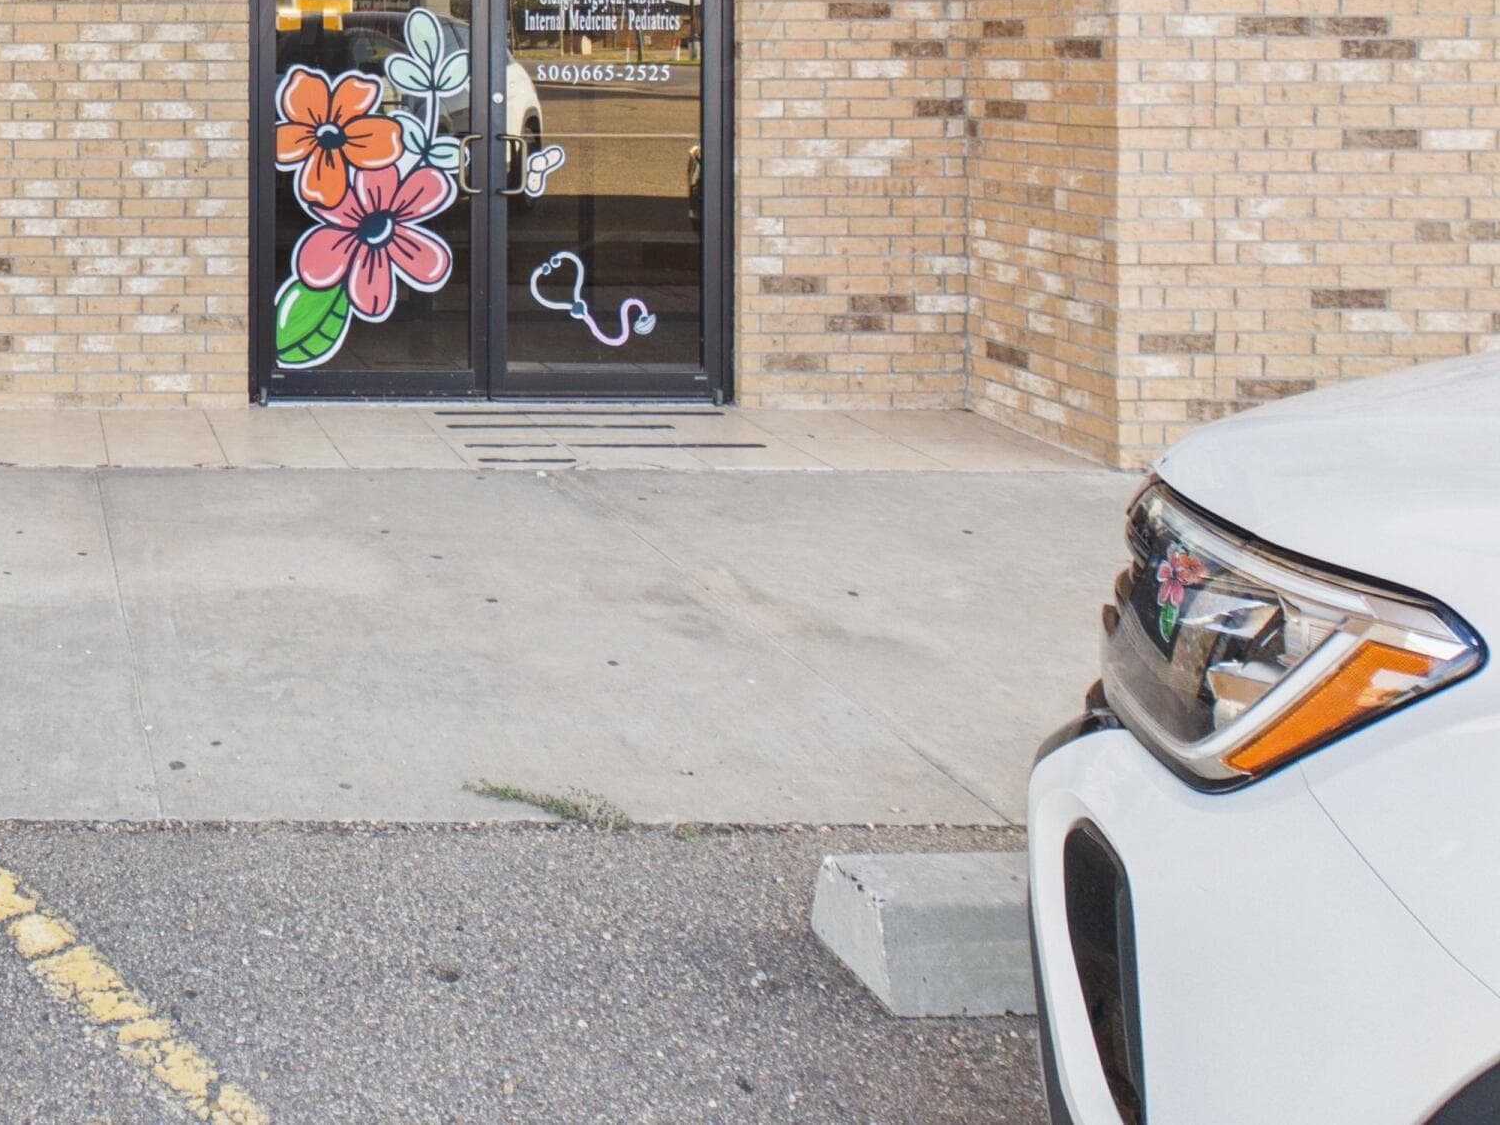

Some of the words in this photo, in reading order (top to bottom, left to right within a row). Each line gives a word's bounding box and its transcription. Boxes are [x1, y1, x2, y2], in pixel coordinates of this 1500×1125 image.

[525, 9, 565, 30] Internal
[569, 9, 617, 30] Medicine
[628, 8, 680, 30] Pediatrics
